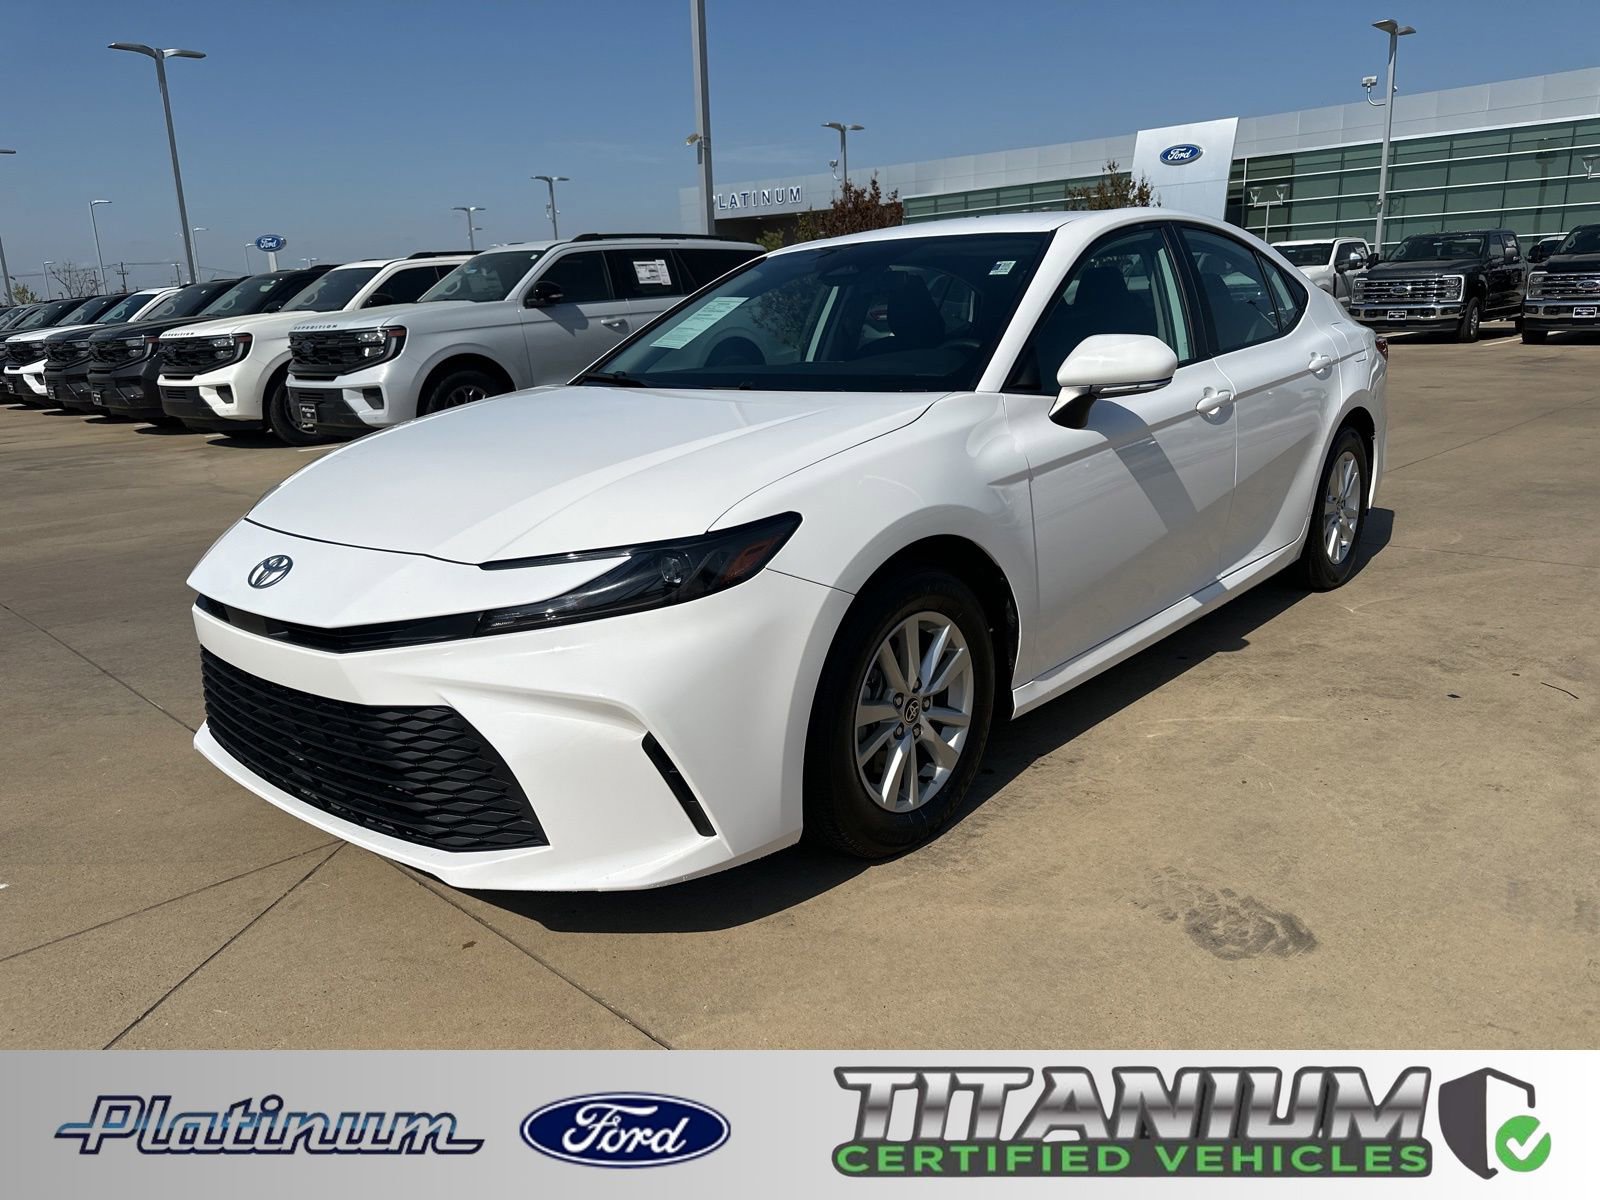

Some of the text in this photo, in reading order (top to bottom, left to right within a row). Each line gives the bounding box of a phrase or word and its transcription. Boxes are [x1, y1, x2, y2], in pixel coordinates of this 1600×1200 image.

[1168, 148, 1192, 161] Ford
[713, 186, 802, 210] LATINUM
[260, 237, 277, 248] Ford
